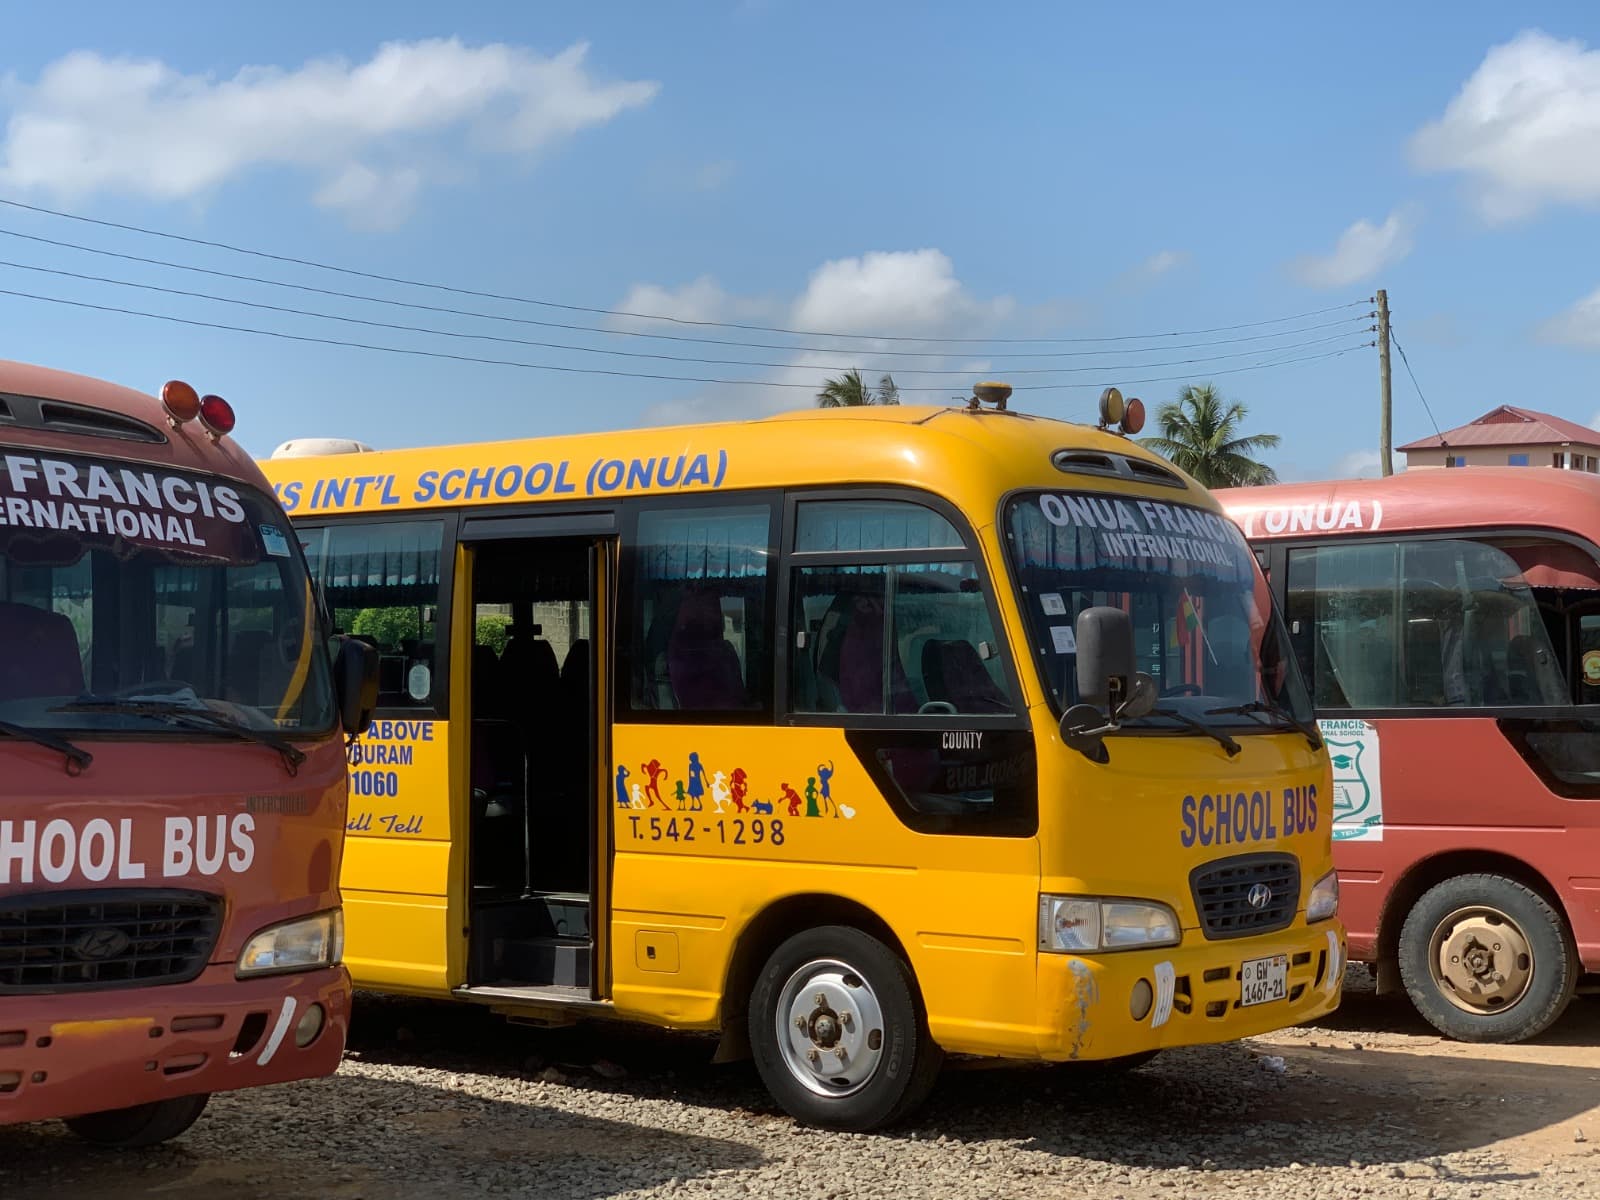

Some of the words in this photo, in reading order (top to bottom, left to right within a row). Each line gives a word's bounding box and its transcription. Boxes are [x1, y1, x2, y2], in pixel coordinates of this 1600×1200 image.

[5, 455, 246, 523] FRANCIS
[310, 475, 400, 509] INT'L
[414, 461, 575, 502] SCHOOL
[586, 449, 727, 496] (ONUA)
[1039, 494, 1141, 532] ONUA
[1102, 532, 1233, 567] INTERNATIONAL
[367, 721, 433, 741] ABOVE
[1320, 720, 1365, 729] FRANCIS
[942, 731, 983, 750] COUNTY
[346, 743, 413, 765] BURAM
[348, 771, 398, 797] 1060
[379, 814, 424, 834] Tell
[1181, 790, 1277, 848] SCHOOL
[1283, 783, 1318, 837] BUS
[0, 816, 146, 884] HOOL
[163, 813, 256, 878] BUS
[1245, 978, 1283, 1003] 1467-21
